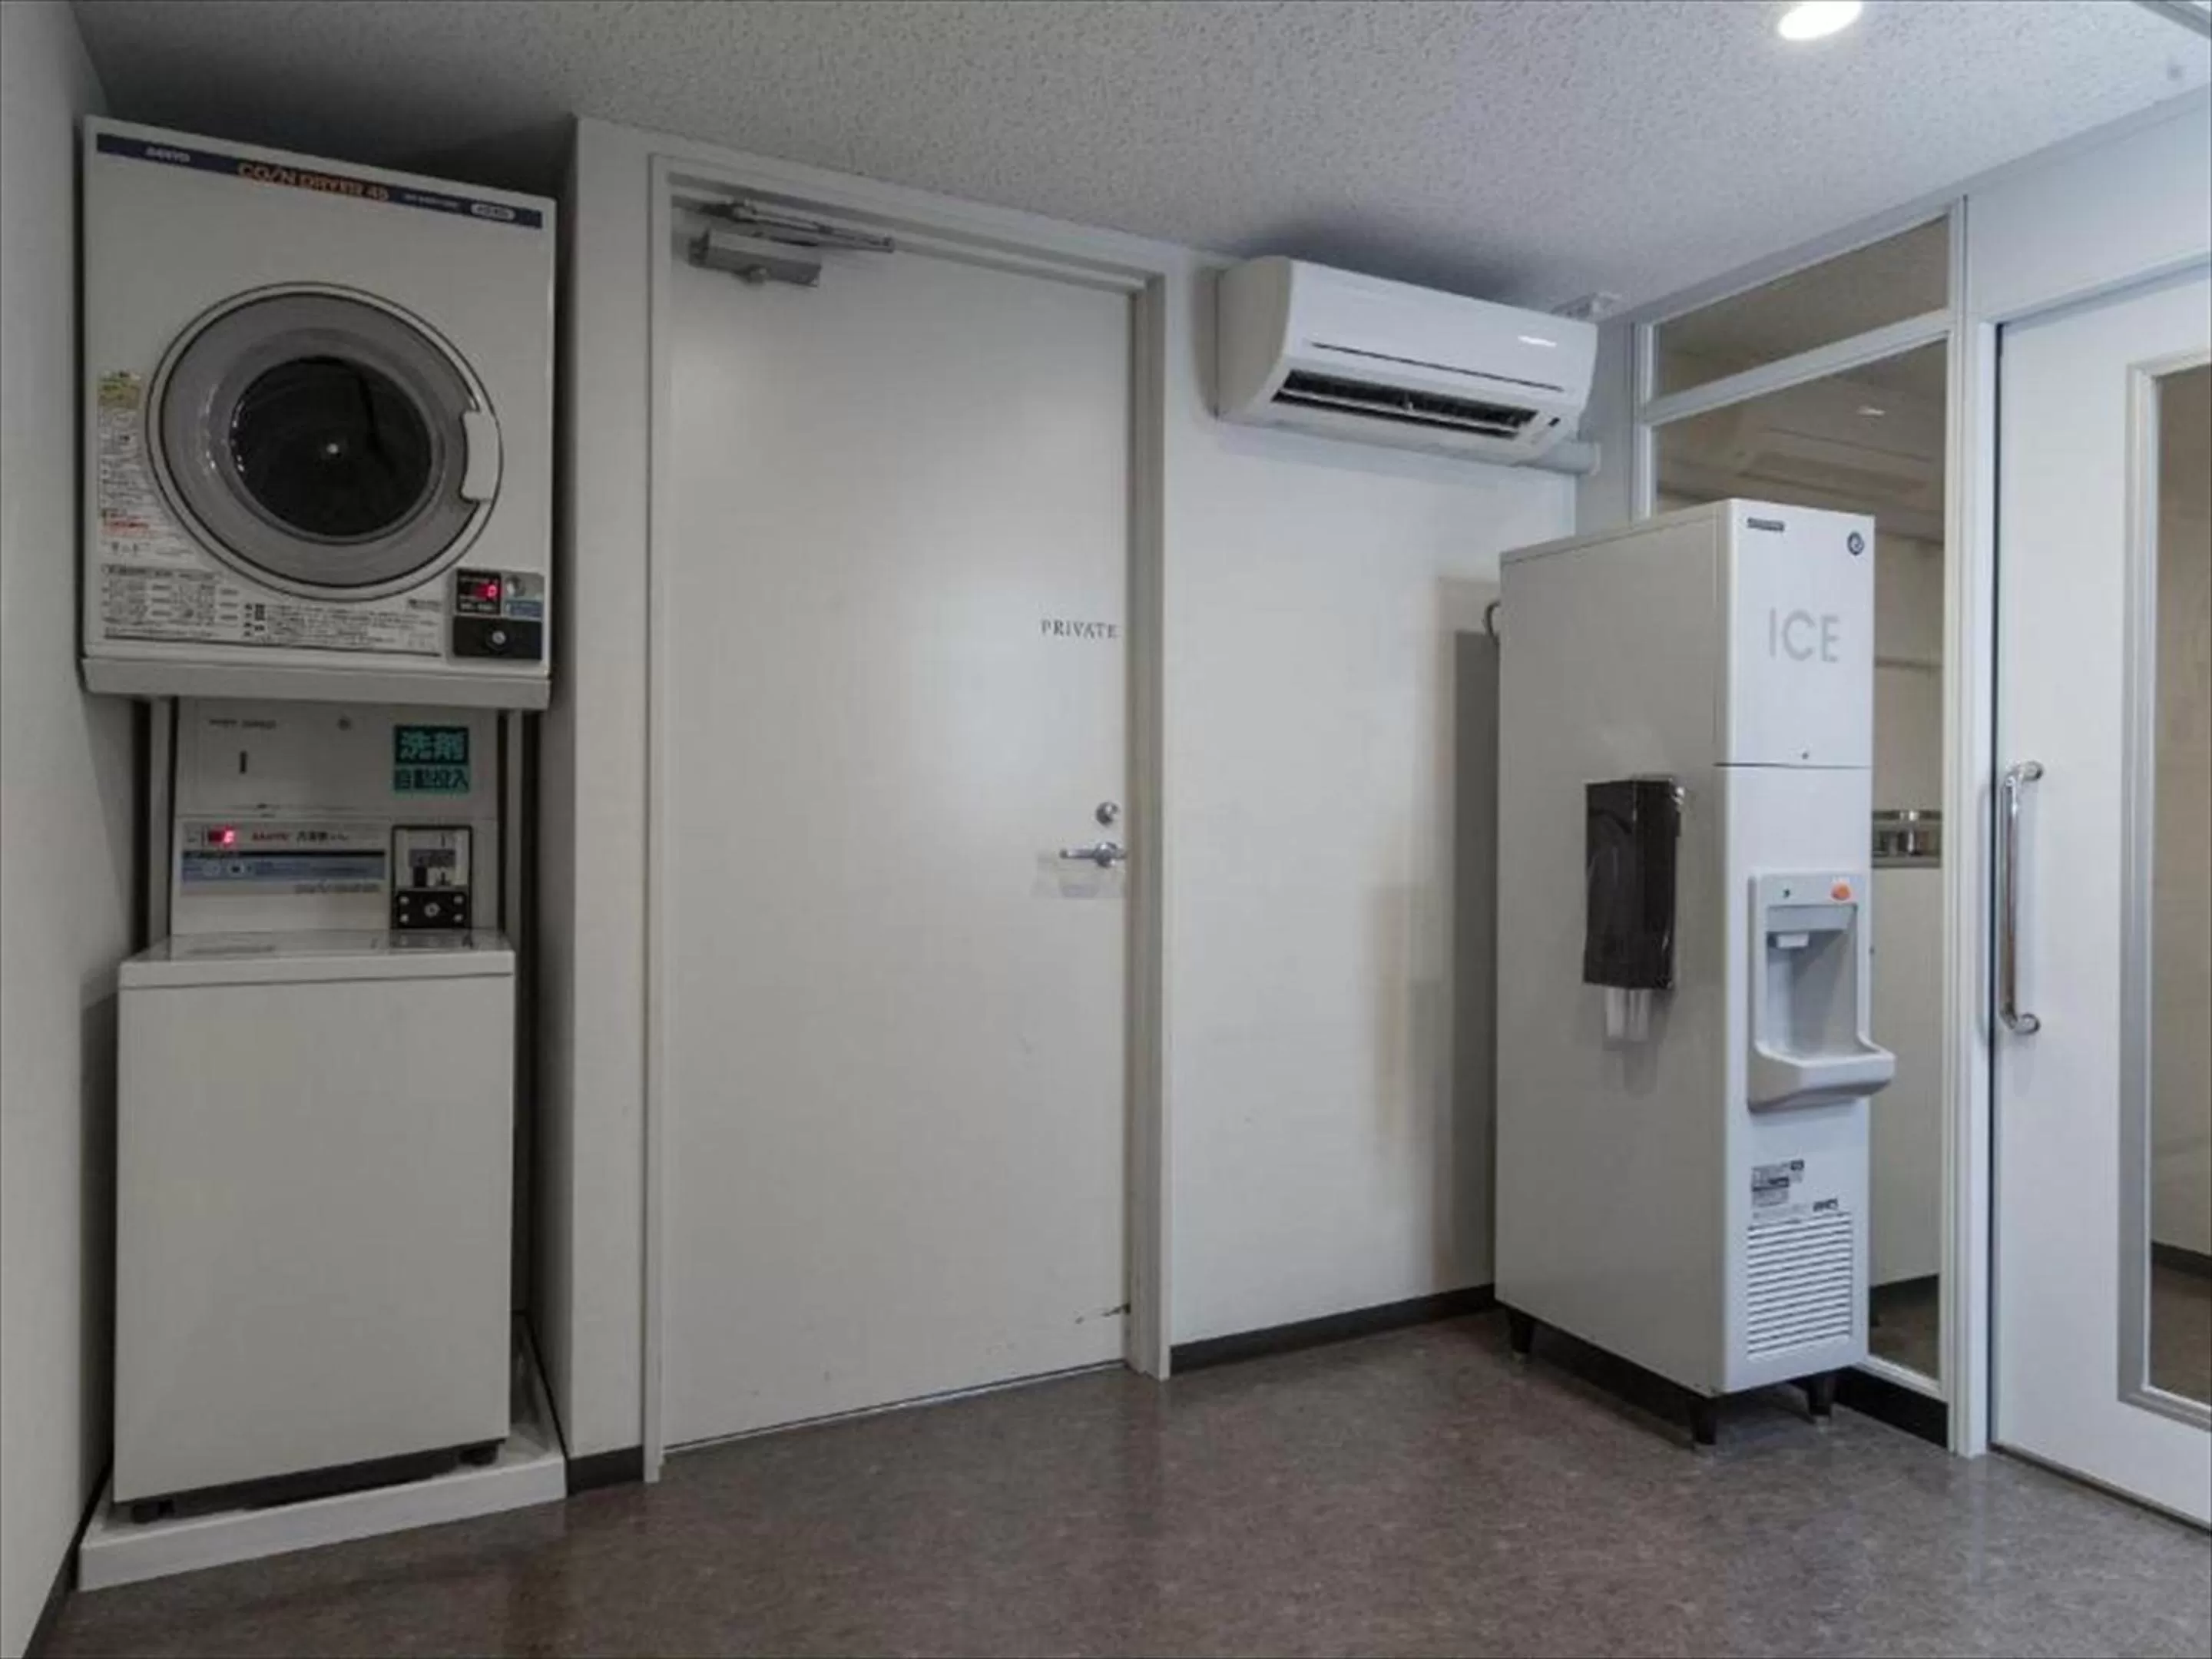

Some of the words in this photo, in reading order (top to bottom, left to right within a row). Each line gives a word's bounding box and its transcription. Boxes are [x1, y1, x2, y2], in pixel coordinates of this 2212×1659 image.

[1041, 619, 1121, 639] PRIVATE
[1769, 608, 1840, 662] ICE
[399, 730, 465, 760] 洗剤
